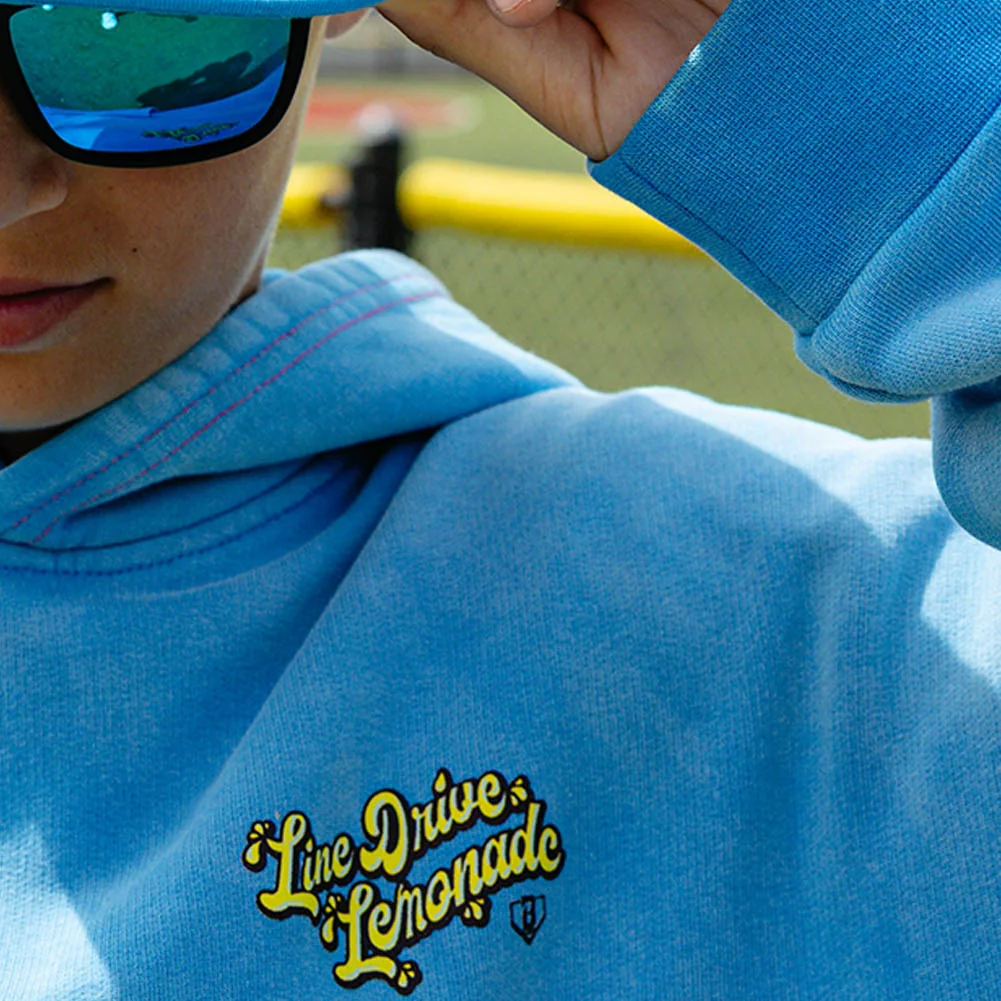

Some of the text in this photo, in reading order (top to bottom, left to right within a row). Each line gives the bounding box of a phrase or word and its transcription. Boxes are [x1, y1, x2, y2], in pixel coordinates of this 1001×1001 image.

[244, 770, 506, 919] Line Drive
[320, 802, 563, 984] Lemonade
